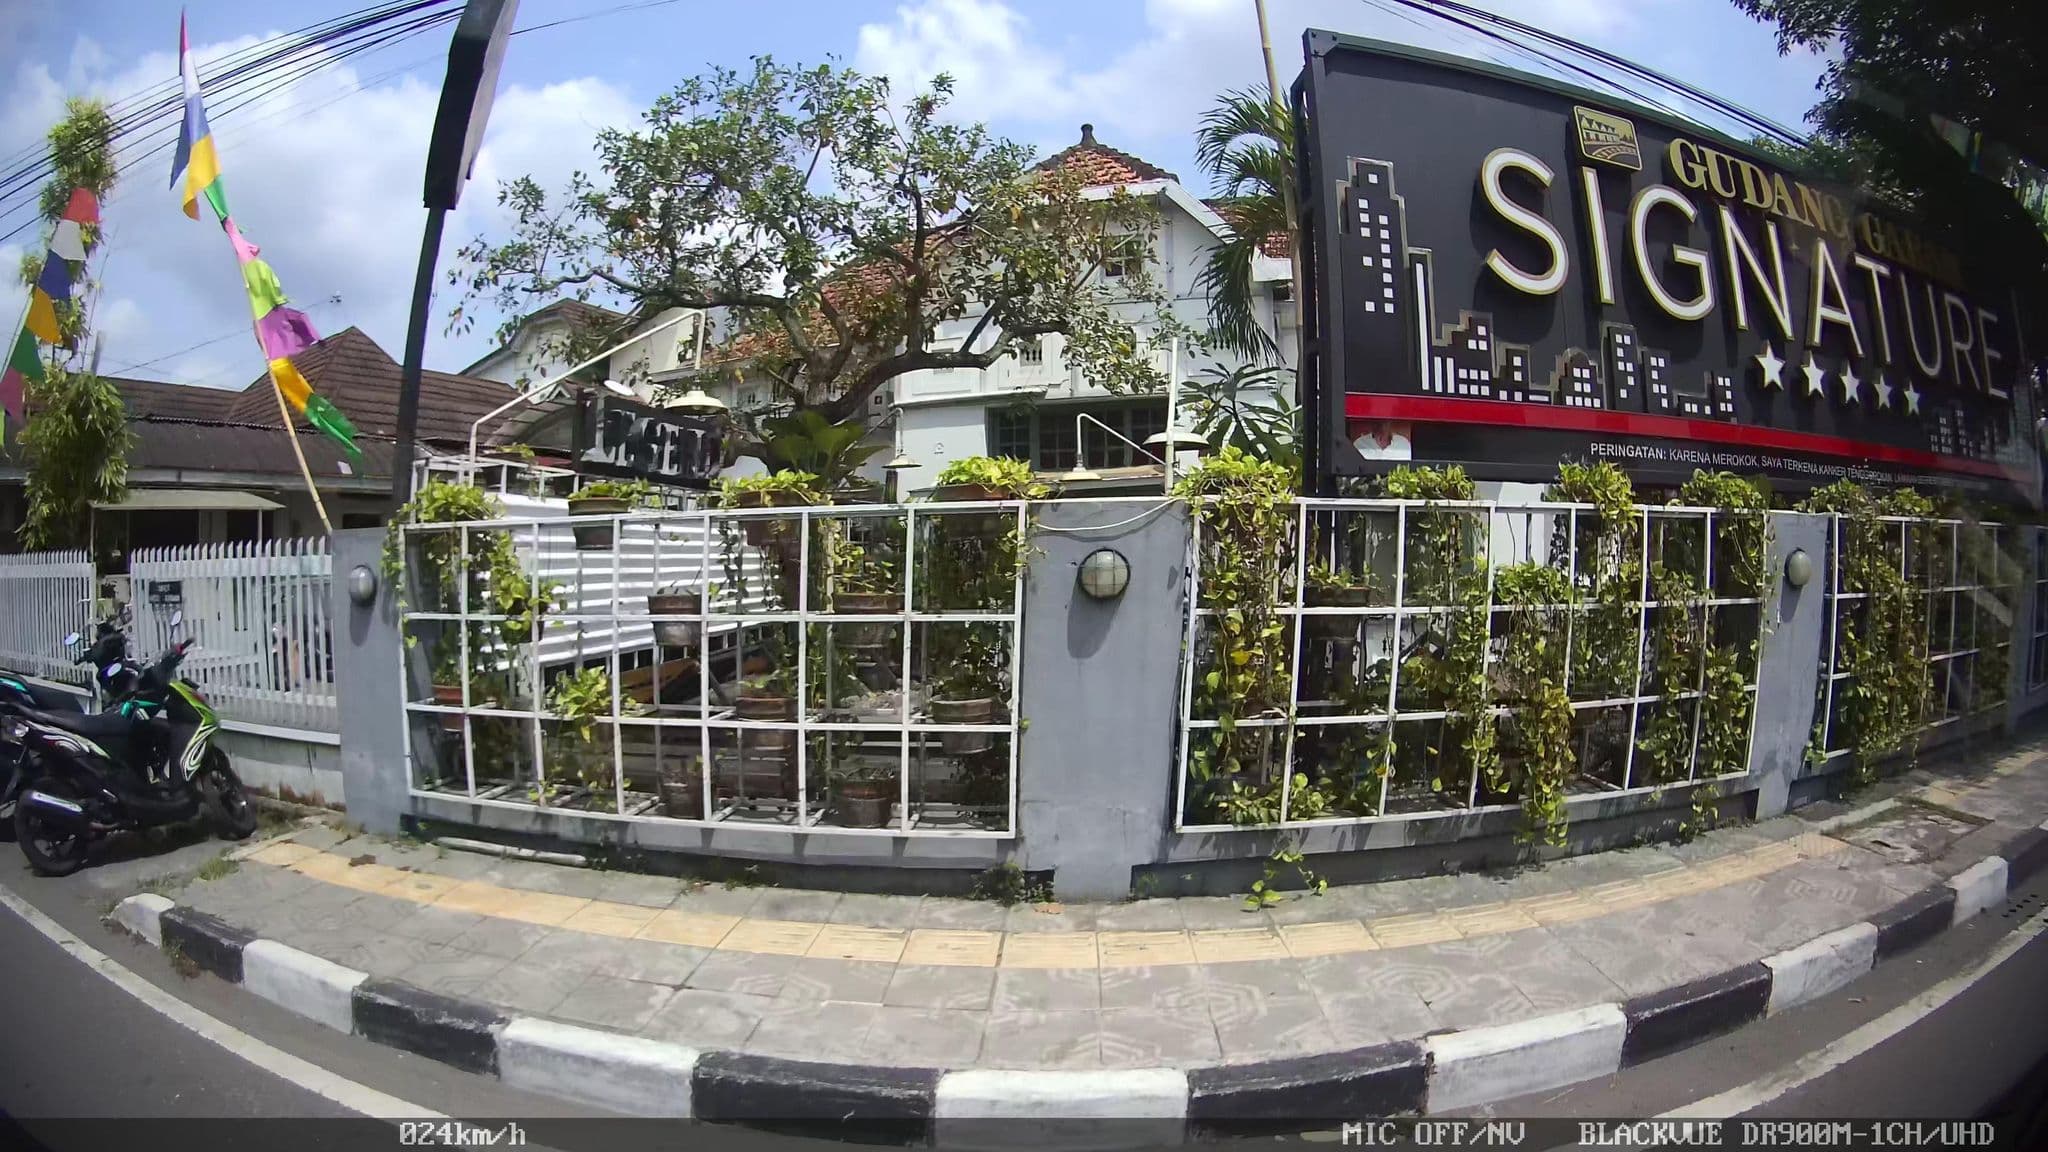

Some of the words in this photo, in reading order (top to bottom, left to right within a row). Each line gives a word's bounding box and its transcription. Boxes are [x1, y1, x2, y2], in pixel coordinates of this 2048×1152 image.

[1668, 137, 1849, 240] GUDANG
[1481, 147, 2009, 400] SIGNATURE
[1590, 442, 1667, 460] PERINGATAN:
[1669, 448, 1711, 465] KARENA
[1761, 455, 1782, 469] SAYA
[1783, 458, 1820, 475] TERKENA
